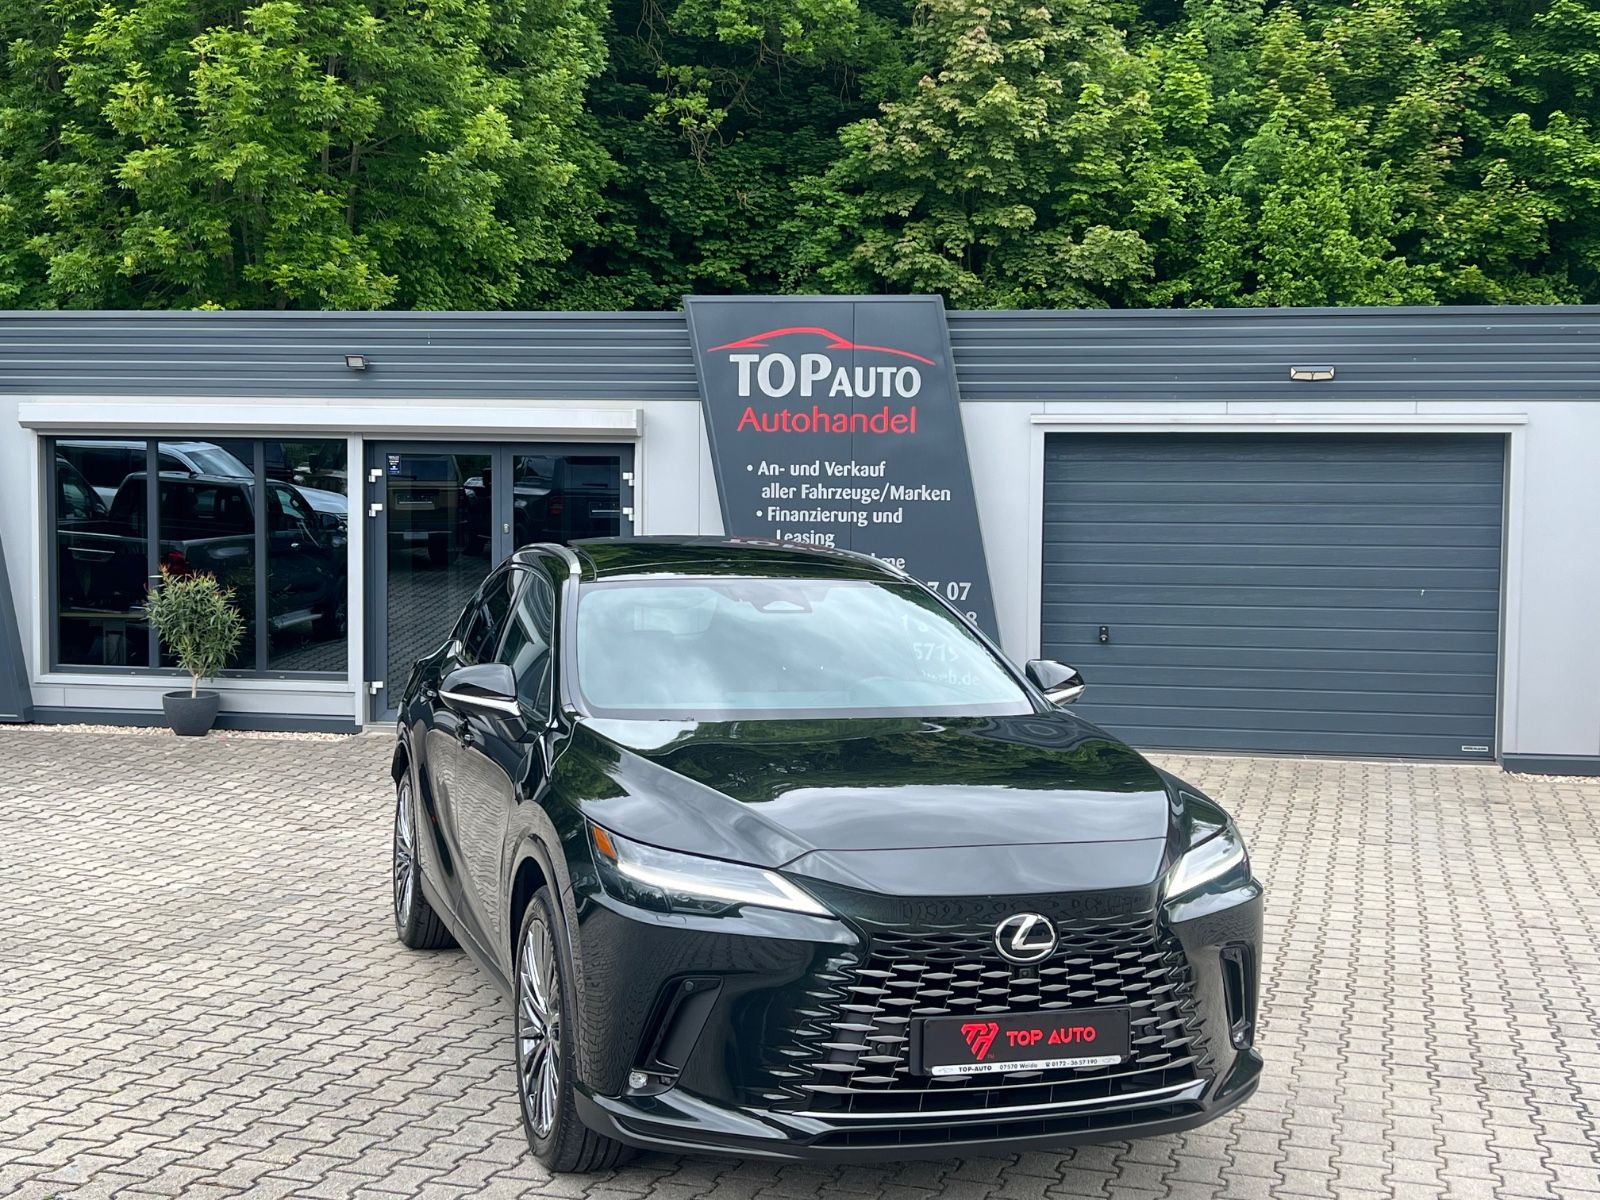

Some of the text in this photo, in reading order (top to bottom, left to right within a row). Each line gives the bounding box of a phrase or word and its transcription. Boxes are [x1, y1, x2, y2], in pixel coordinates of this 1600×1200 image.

[736, 405, 917, 433] Autohandel
[757, 461, 887, 478] An- und Verkauf
[761, 483, 951, 505] aller Fahrzeuge/Marken
[767, 506, 903, 527] Finanzierung und
[946, 581, 972, 601] 07
[1006, 1026, 1097, 1047] TOP AUTO
[958, 1065, 993, 1073] TOP-AUTO
